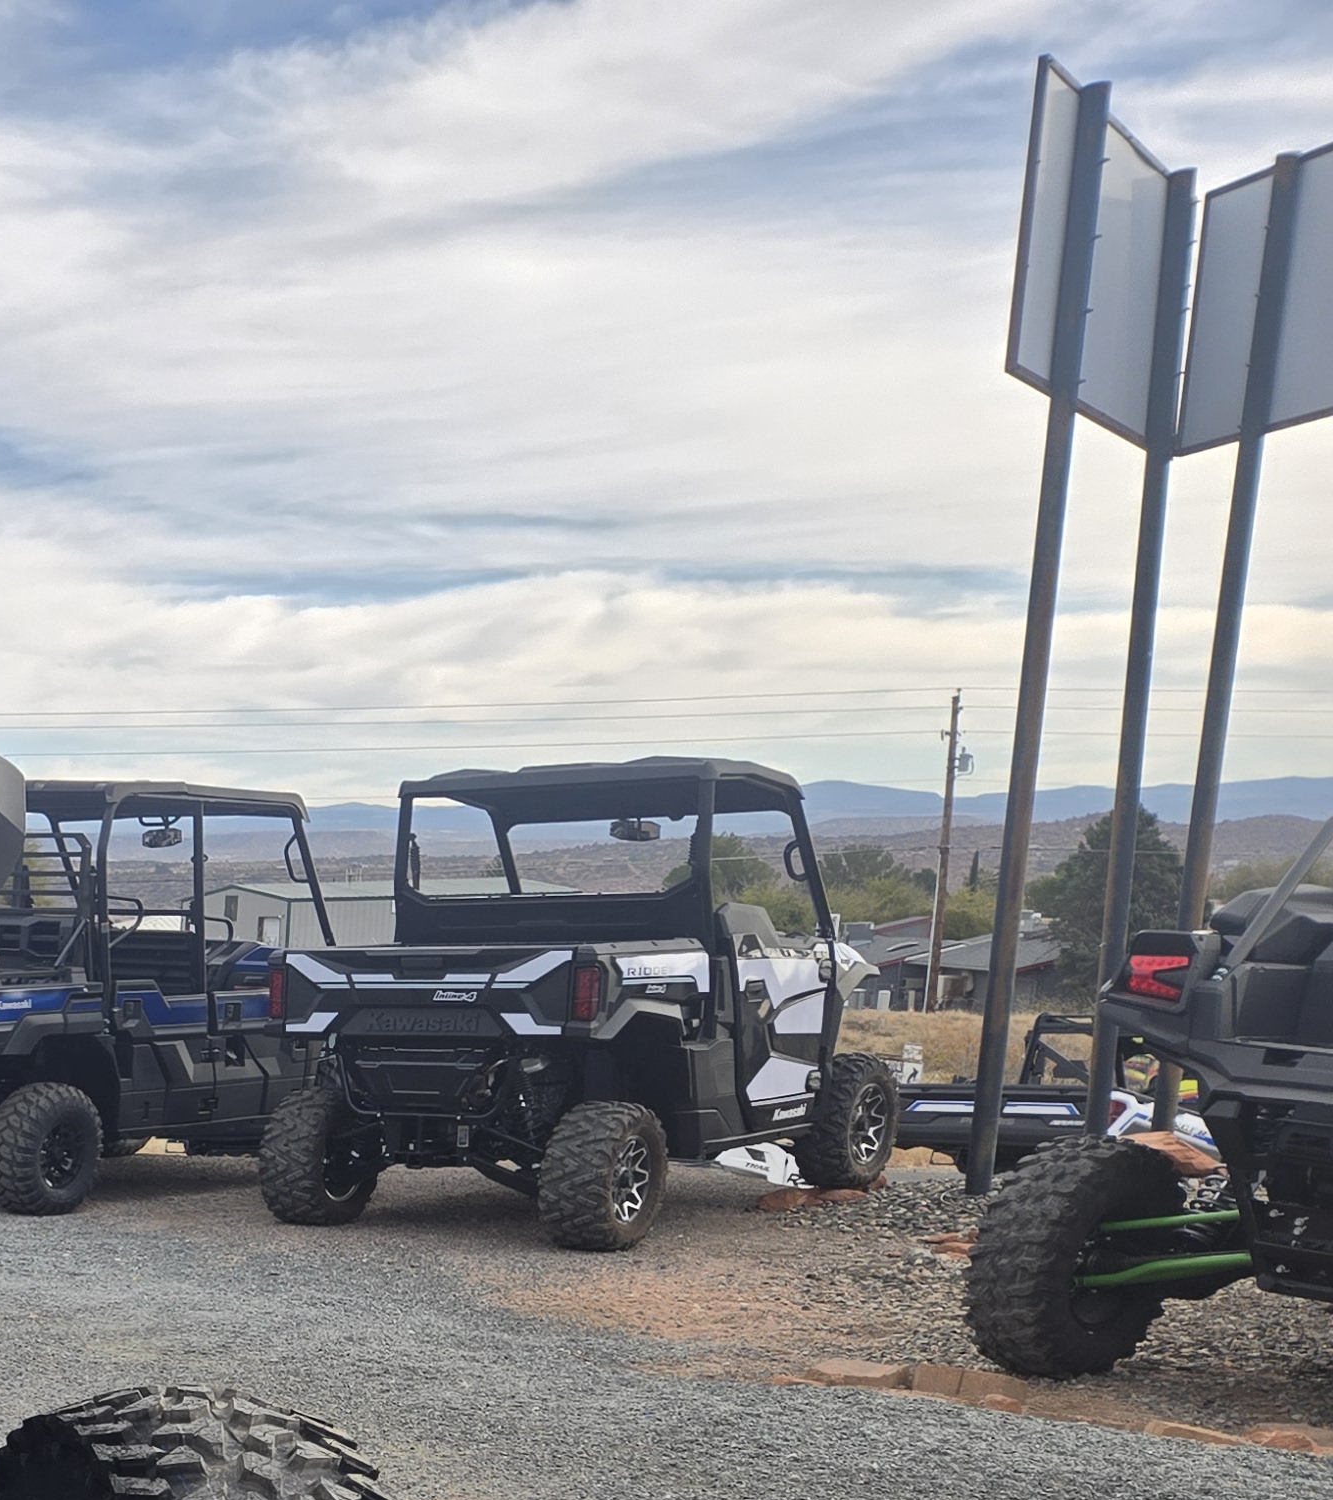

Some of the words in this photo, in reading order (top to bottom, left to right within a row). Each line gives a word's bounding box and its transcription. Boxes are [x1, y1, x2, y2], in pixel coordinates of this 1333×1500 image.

[627, 966, 668, 977] RIDGE
[366, 1010, 480, 1034] Kawasaki
[772, 1102, 807, 1121] Kawasaki
